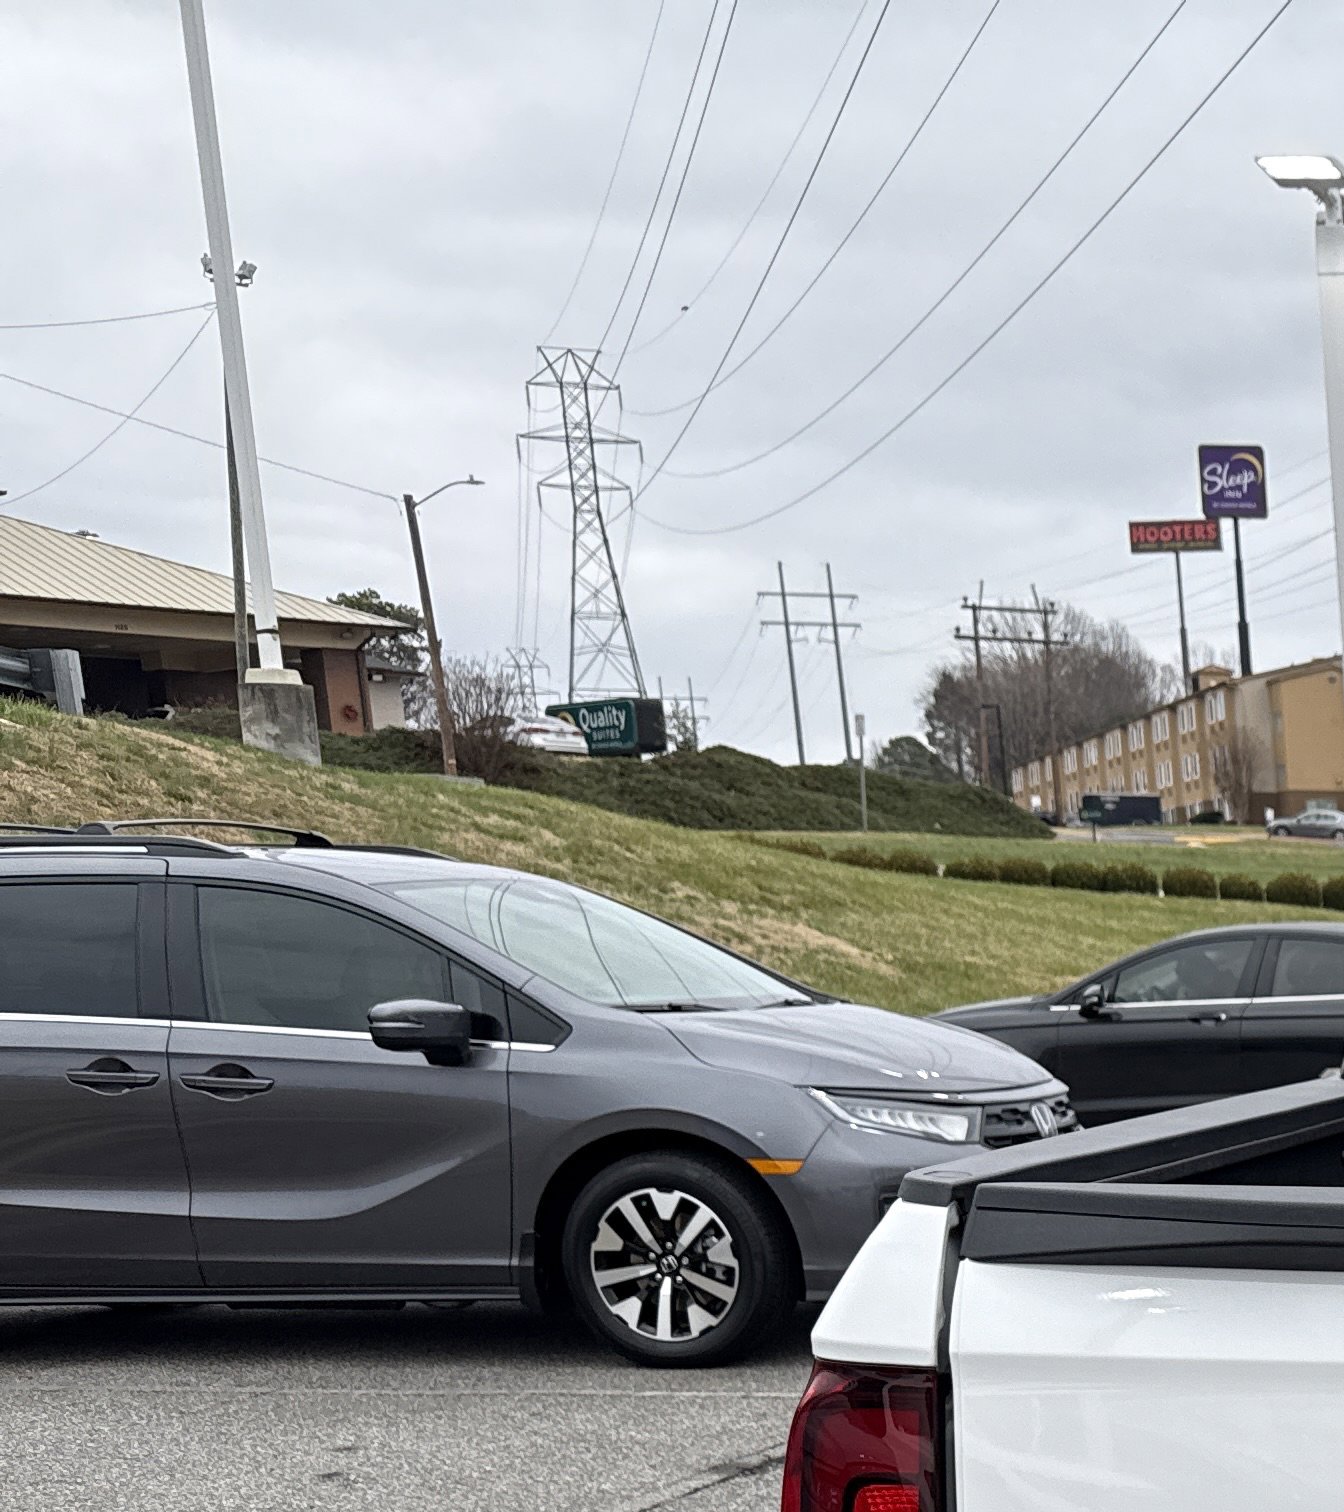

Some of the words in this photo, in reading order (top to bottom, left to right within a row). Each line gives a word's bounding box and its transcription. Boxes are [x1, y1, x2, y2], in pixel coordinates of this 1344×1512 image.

[1202, 462, 1256, 495] Sleep
[1131, 523, 1217, 543] HOOTERS
[579, 705, 626, 733] Quality
